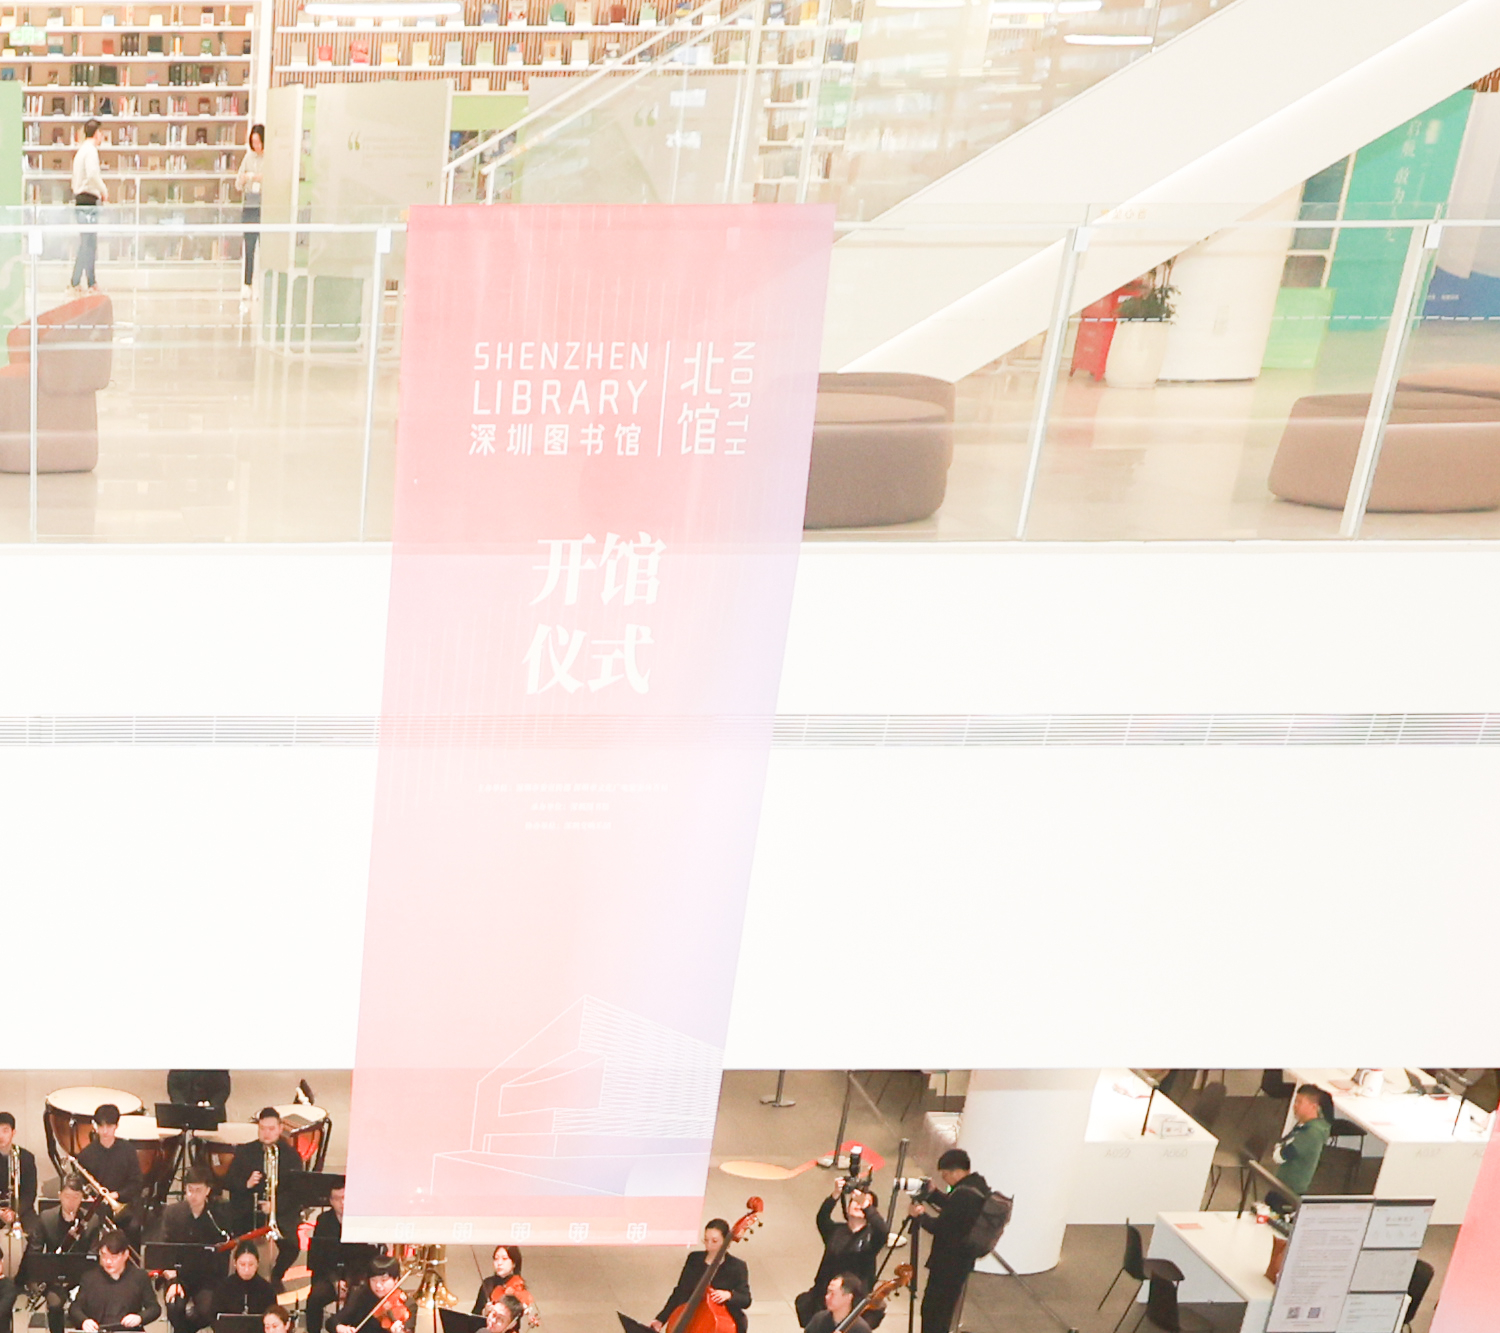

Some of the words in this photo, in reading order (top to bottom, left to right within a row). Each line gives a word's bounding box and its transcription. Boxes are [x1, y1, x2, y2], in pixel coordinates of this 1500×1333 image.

[472, 340, 649, 371] SHENZHEN
[472, 379, 649, 416] LIBRARY
[676, 341, 725, 456] 北馆
[724, 341, 756, 456] NORTH
[467, 422, 643, 457] 深圳图书馆
[529, 531, 668, 607] 开馆
[521, 622, 655, 697] 仪式
